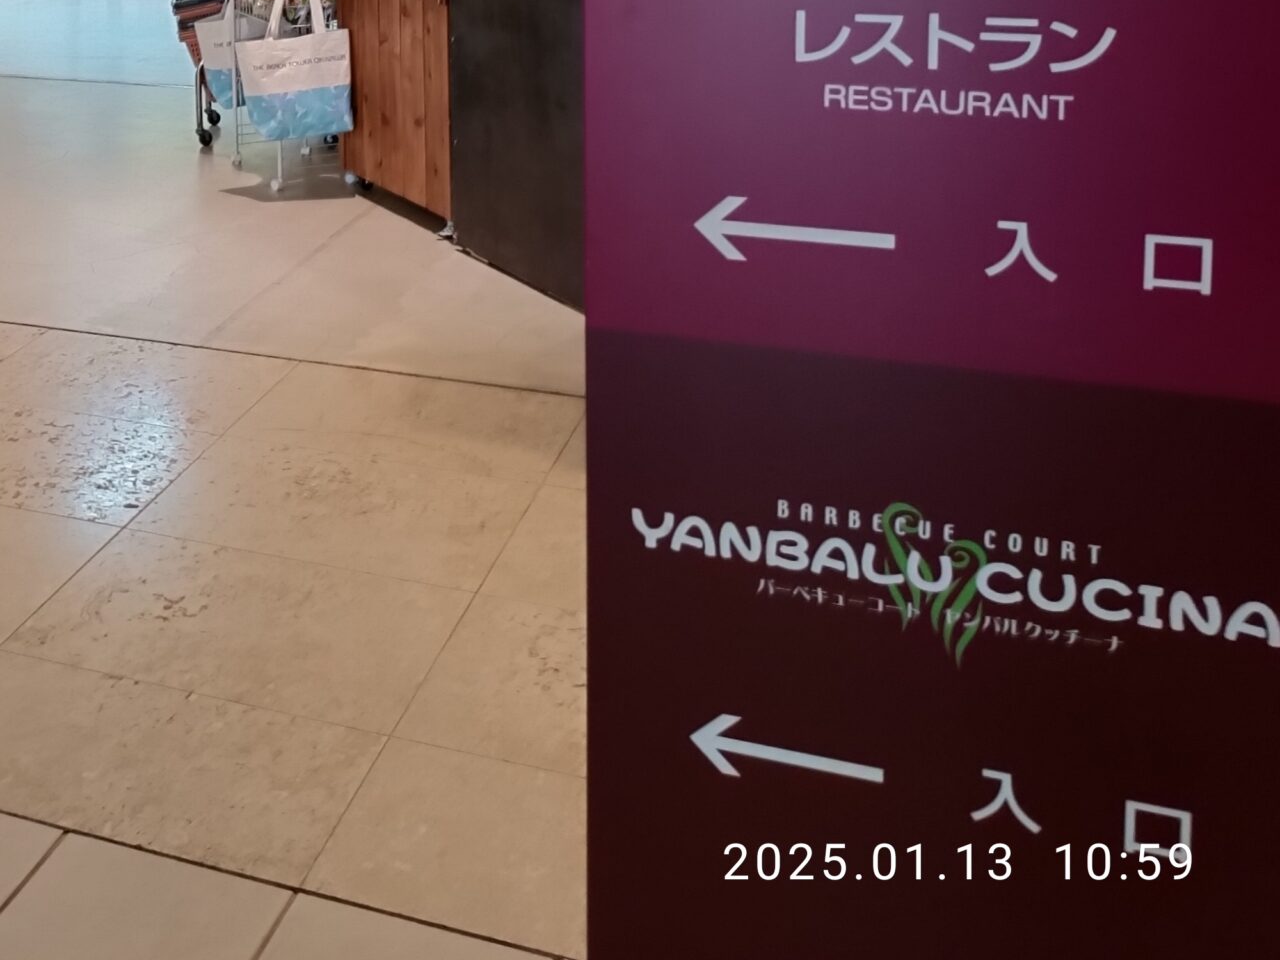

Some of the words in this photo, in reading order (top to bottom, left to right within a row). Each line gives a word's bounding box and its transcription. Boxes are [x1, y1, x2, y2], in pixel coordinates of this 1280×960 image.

[793, 9, 1117, 73] レストラン
[822, 83, 1075, 121] RESTAURANT
[776, 498, 957, 544] BARBECUE
[983, 528, 1104, 566] COURT
[630, 507, 954, 593] YANBALU
[974, 561, 1280, 648] CUCINA
[942, 607, 1125, 653] ヤンバルクッチーナ
